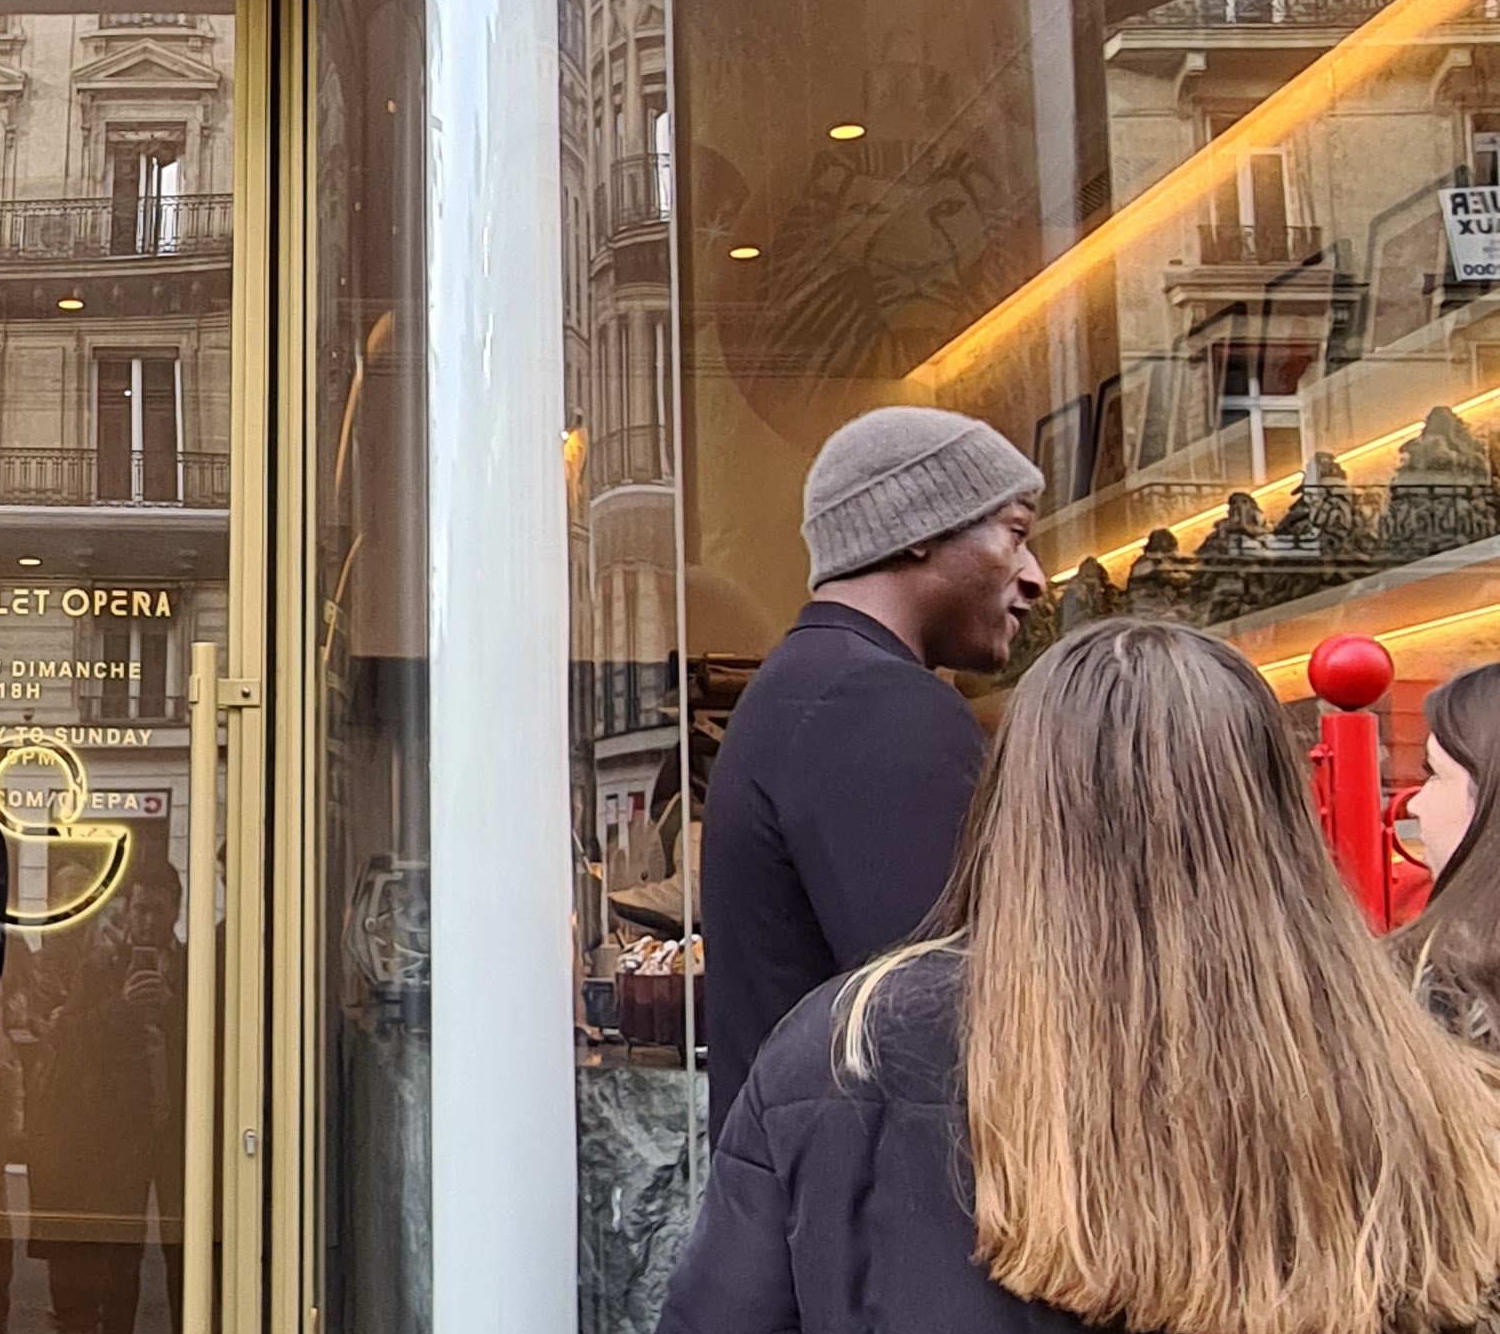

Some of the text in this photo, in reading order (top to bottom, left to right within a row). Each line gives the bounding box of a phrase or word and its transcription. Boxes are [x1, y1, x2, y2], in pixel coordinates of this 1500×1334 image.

[62, 588, 171, 617] OPERA
[12, 660, 142, 679] DIMANCHE
[15, 726, 45, 743] TO
[55, 727, 152, 746] SUNDAY
